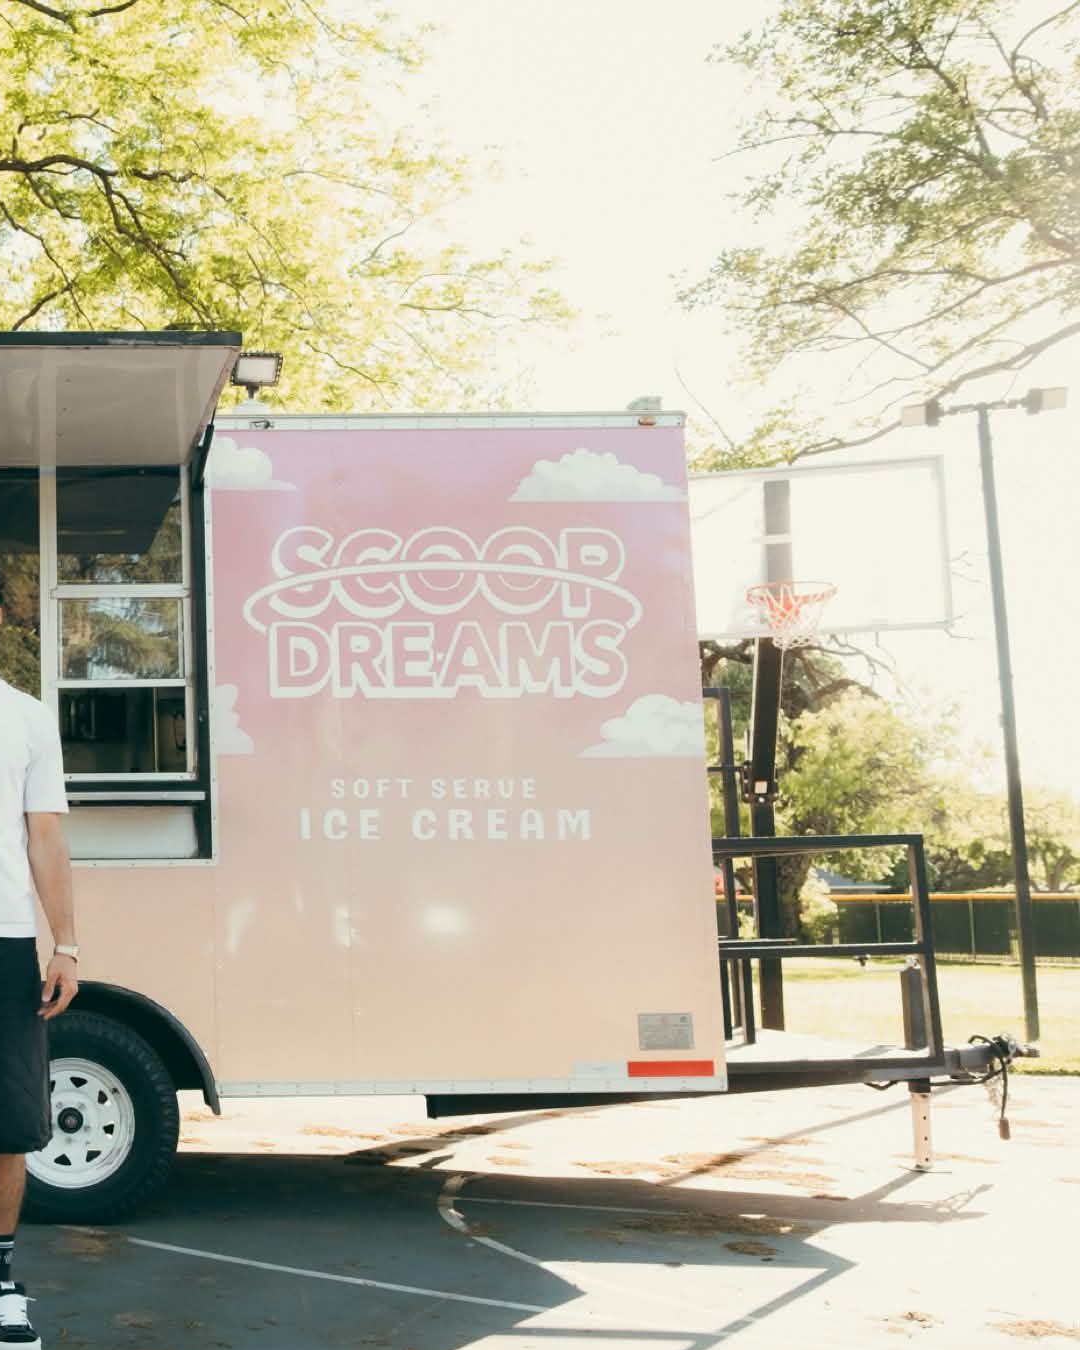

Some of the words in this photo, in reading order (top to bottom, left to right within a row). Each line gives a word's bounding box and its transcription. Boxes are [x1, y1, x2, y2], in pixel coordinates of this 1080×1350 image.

[269, 526, 625, 618] SCOOP
[268, 620, 629, 699] DREAMS
[330, 778, 413, 799] SOFT
[431, 778, 538, 799] SERVE
[299, 808, 381, 841] ICE
[411, 808, 592, 841] CREAM
